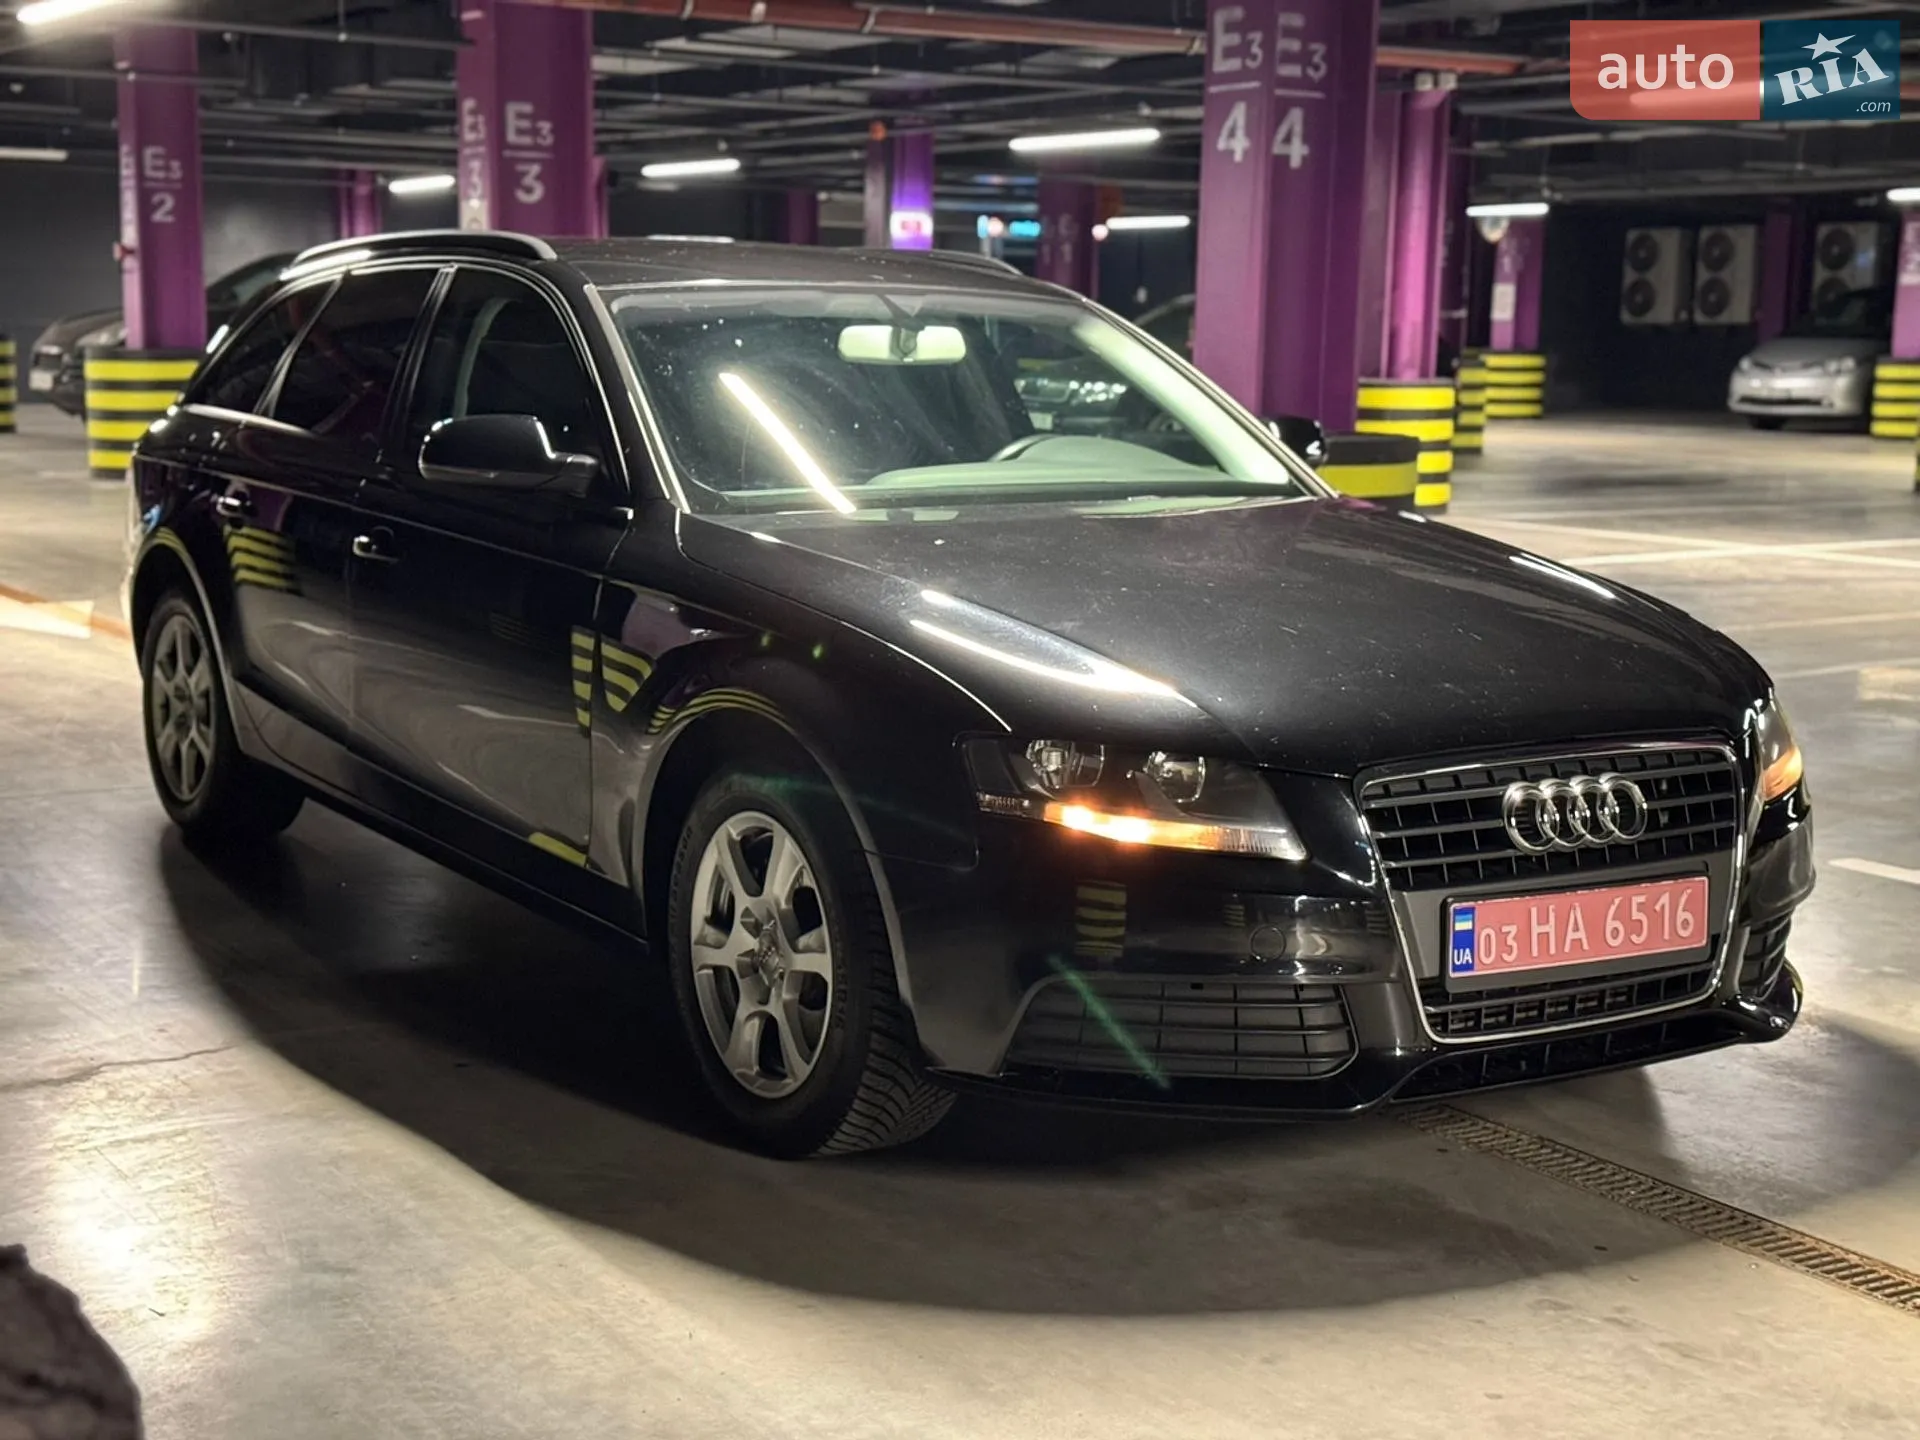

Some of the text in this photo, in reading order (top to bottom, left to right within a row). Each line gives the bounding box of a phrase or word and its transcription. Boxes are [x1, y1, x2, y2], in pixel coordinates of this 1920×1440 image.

[1212, 6, 1264, 73] E3
[1276, 12, 1327, 82] E3
[505, 101, 555, 146] E3
[1216, 101, 1250, 163] 4
[1272, 106, 1310, 169] 4
[150, 192, 176, 223] 2
[514, 162, 545, 204] 3
[1453, 948, 1473, 965] UA
[1479, 888, 1694, 965] 03 HA 6516
